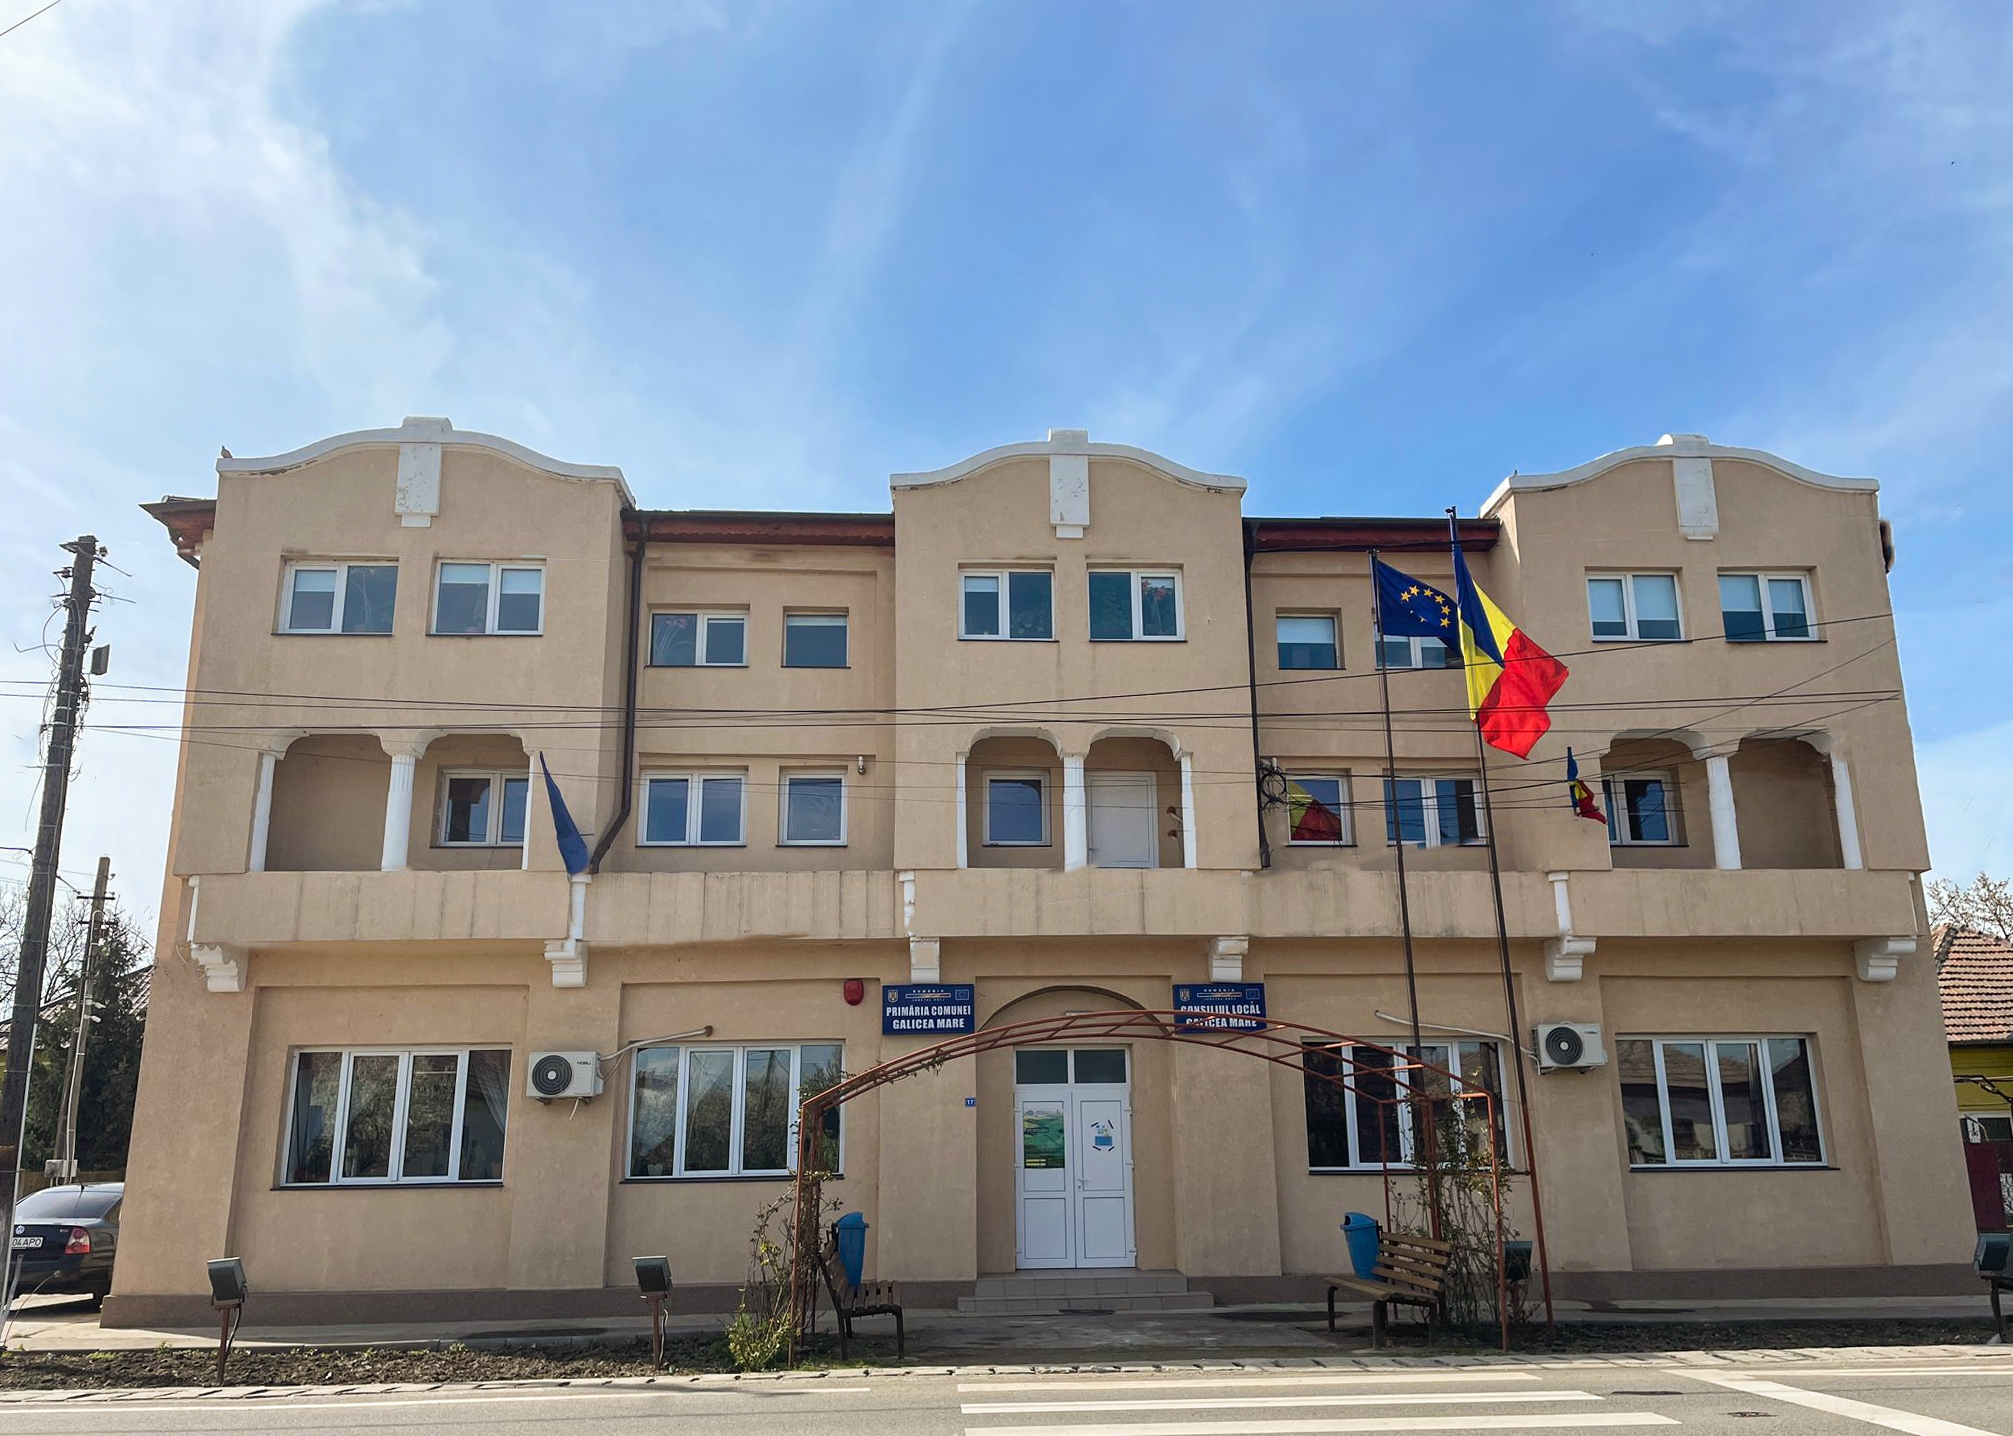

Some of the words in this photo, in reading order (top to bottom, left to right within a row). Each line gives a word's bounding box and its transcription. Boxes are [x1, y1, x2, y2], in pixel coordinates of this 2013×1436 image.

[886, 1005, 930, 1016] PRIMĂRIA
[931, 1005, 971, 1015] COMUNEI
[1231, 1004, 1260, 1014] LOCAL
[893, 1019, 935, 1029] GALICEA
[937, 1019, 965, 1028] MARE
